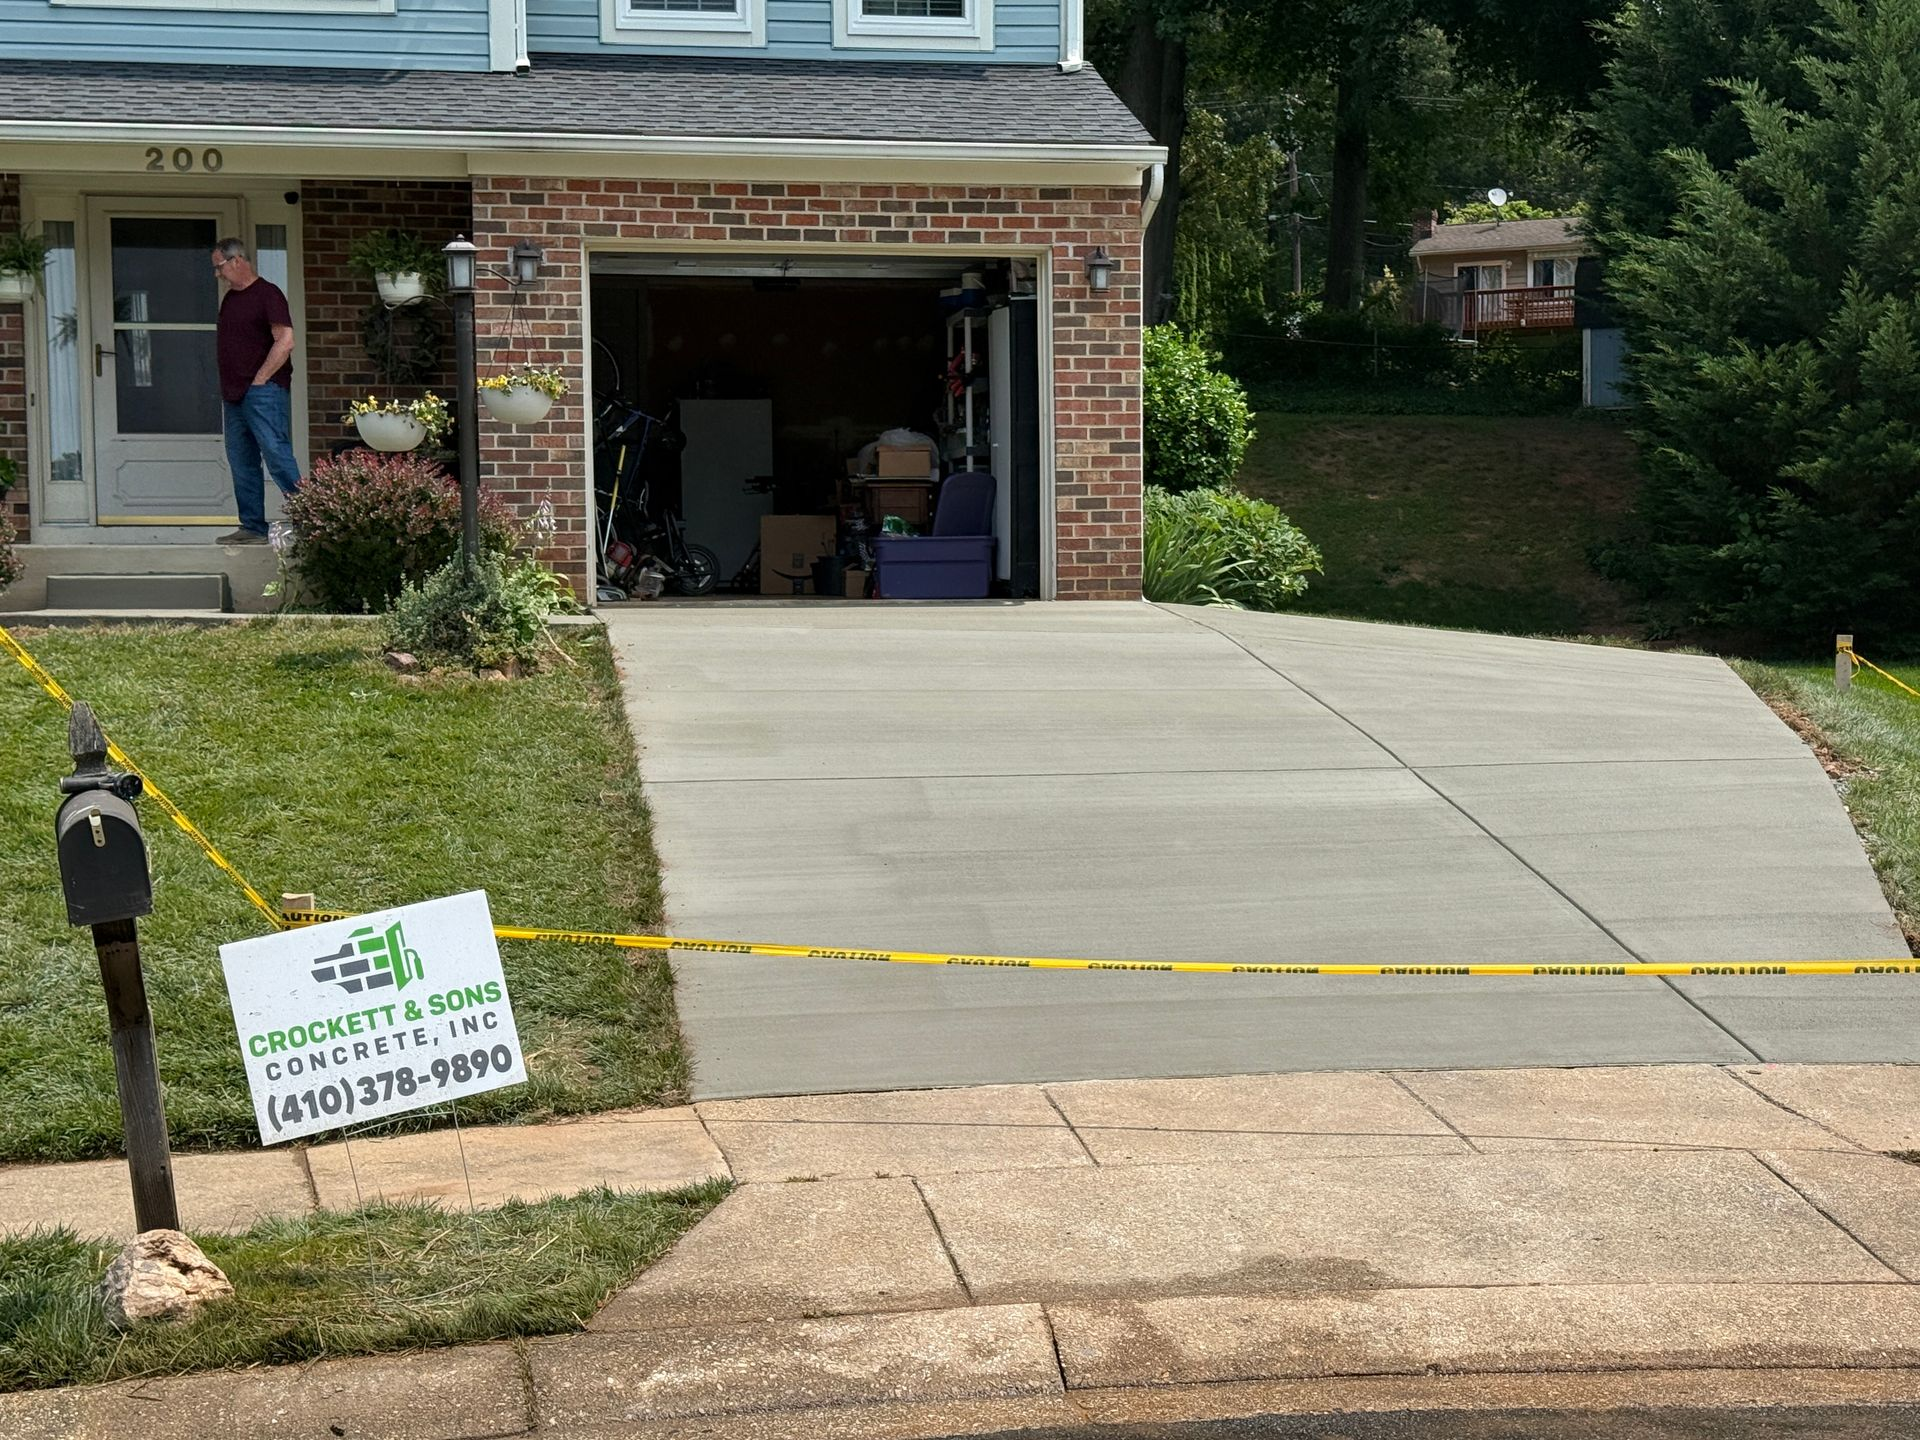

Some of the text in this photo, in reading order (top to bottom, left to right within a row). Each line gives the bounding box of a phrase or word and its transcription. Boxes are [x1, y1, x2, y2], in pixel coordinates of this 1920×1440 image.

[145, 147, 223, 172] 200
[248, 981, 502, 1057] CROCKETT & SONS
[266, 1011, 498, 1081] CONCRETE, INC
